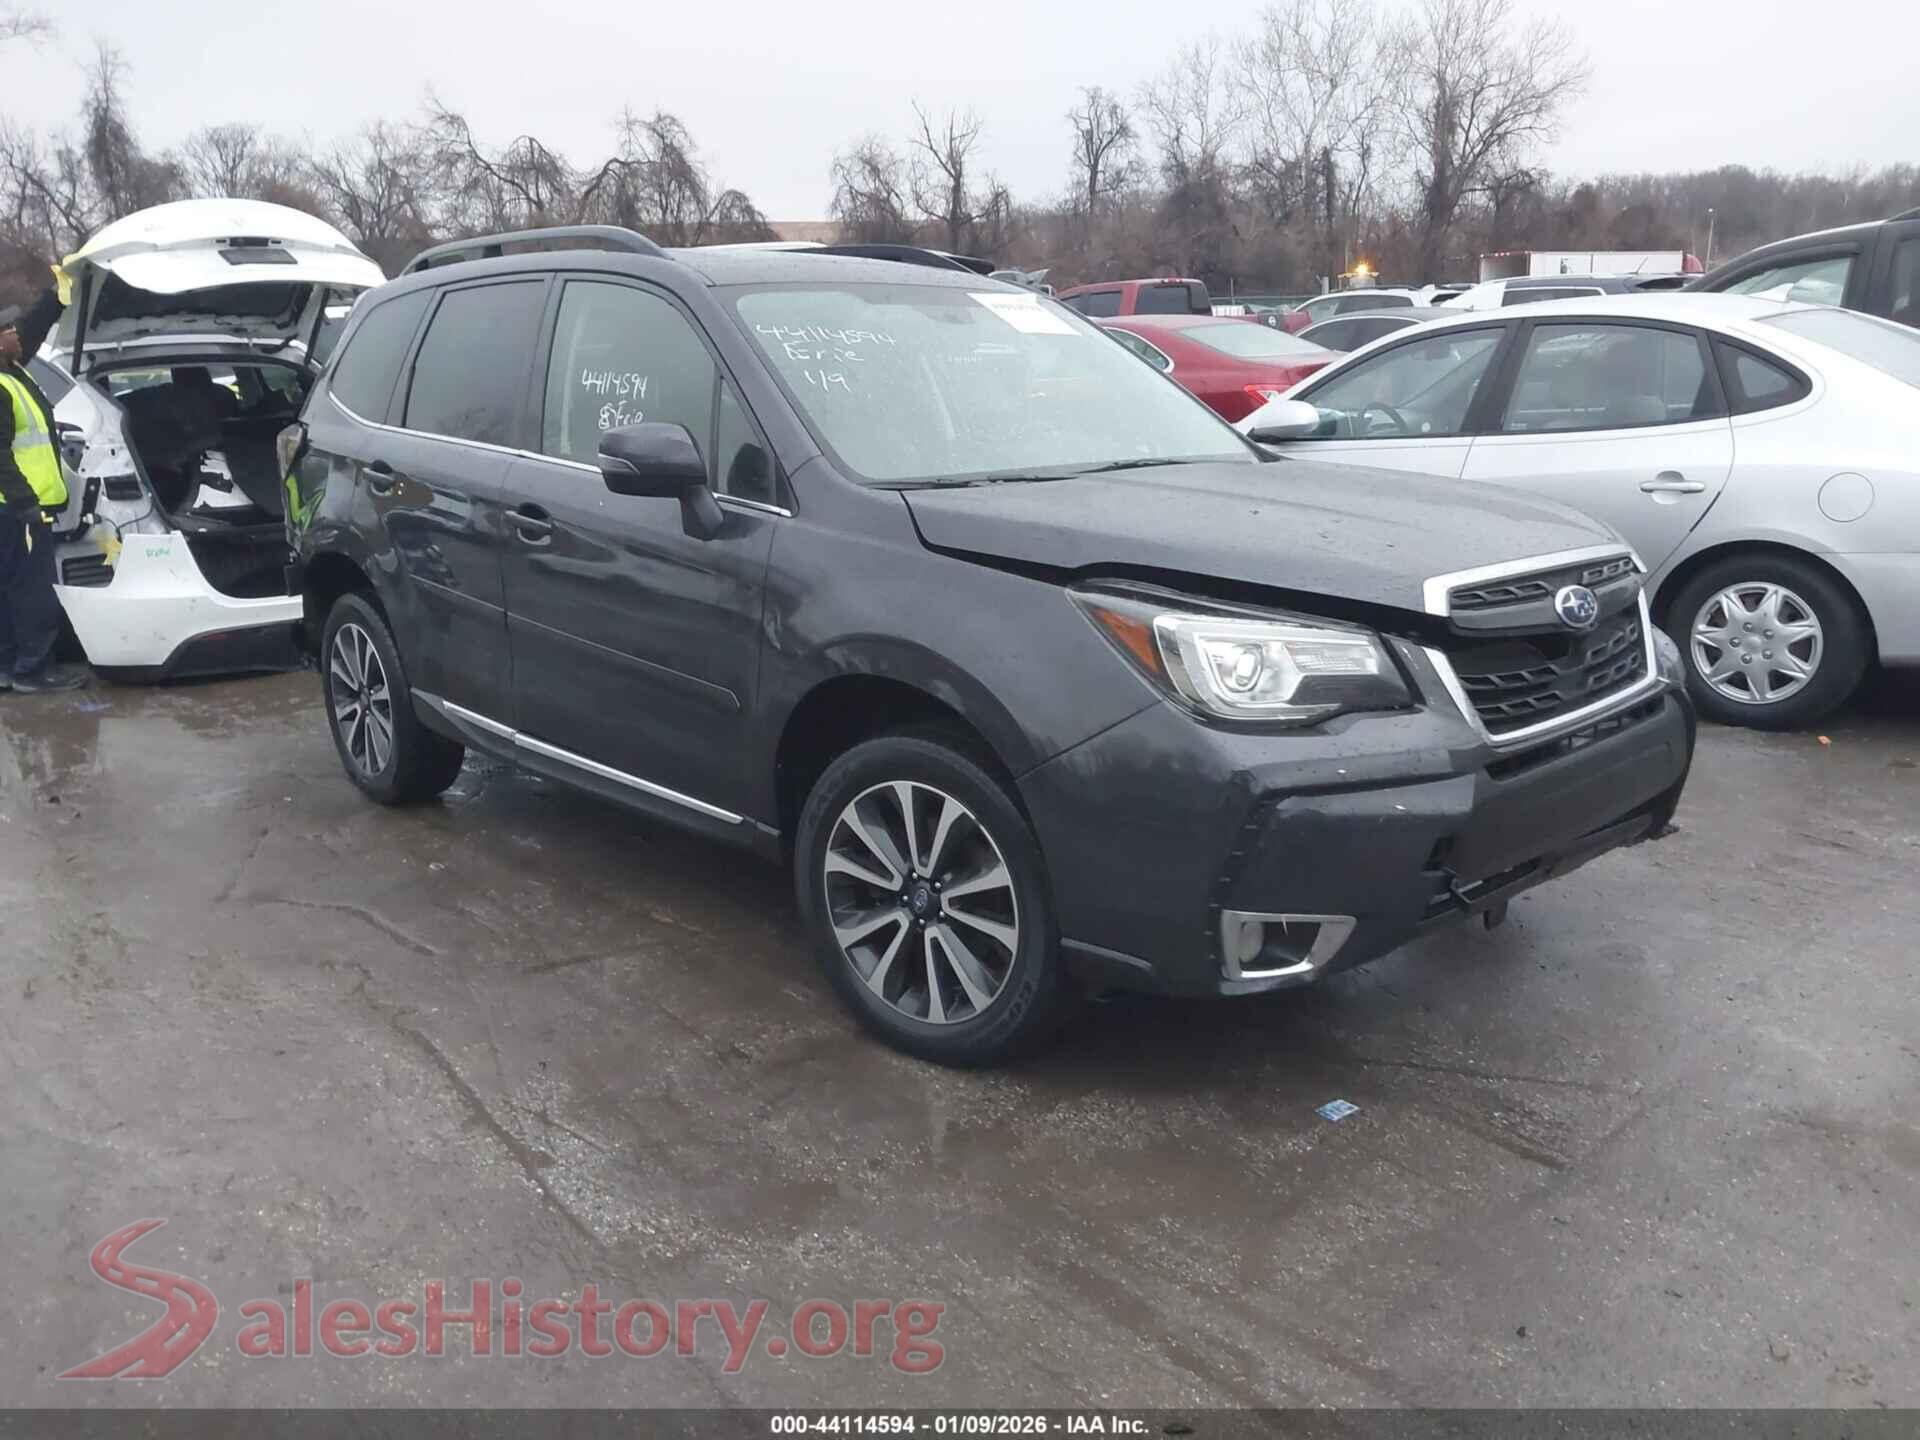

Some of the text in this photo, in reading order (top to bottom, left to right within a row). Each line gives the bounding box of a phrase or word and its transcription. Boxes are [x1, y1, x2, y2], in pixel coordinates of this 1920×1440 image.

[756, 323, 897, 345] 44114594
[582, 368, 648, 400] 44114594
[803, 369, 851, 392] 1/9
